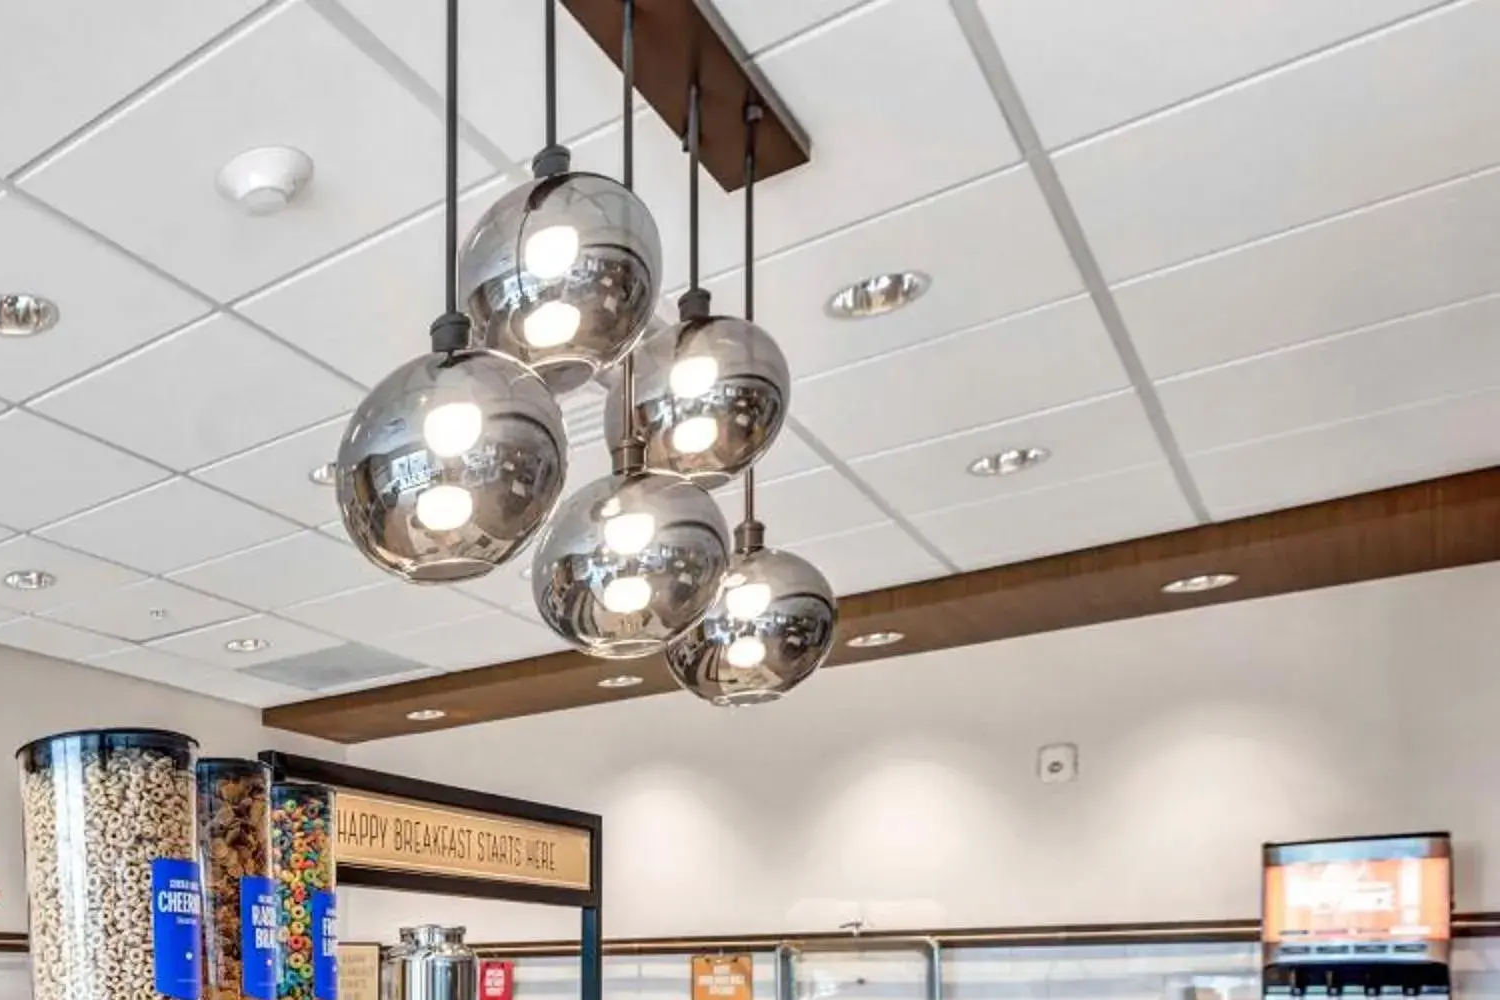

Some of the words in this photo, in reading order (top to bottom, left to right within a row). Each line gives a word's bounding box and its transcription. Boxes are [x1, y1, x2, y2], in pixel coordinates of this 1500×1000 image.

[337, 809, 389, 850] HAPPY
[393, 818, 473, 860] BREAKFAST
[476, 831, 522, 868] STARTS
[526, 838, 557, 872] HERE
